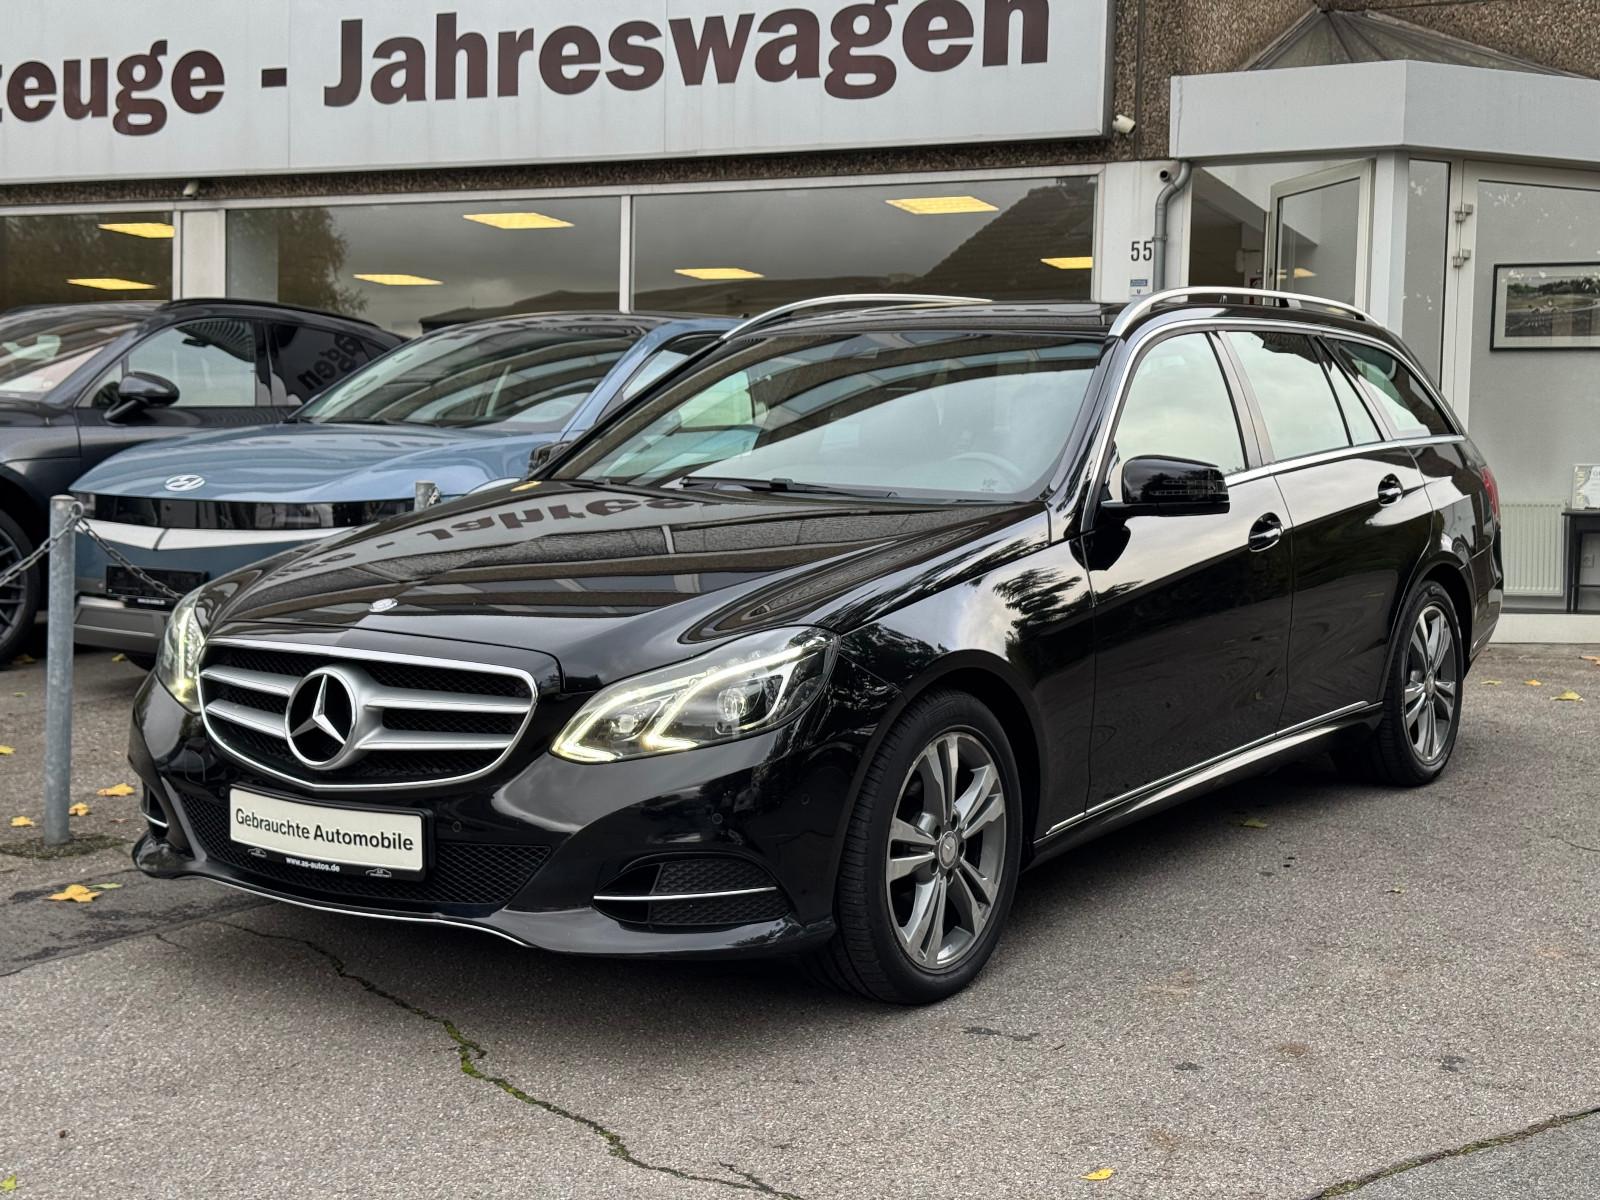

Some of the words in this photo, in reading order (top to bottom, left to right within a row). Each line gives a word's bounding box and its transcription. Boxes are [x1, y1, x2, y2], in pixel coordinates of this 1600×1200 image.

[0, 40, 225, 137] euge
[323, 0, 1050, 108] Jahreswagen
[1130, 240, 1153, 262] 55
[235, 807, 310, 841] Gebrauchte
[313, 824, 414, 852] Automobile
[285, 856, 341, 873] www.as-autos.de
